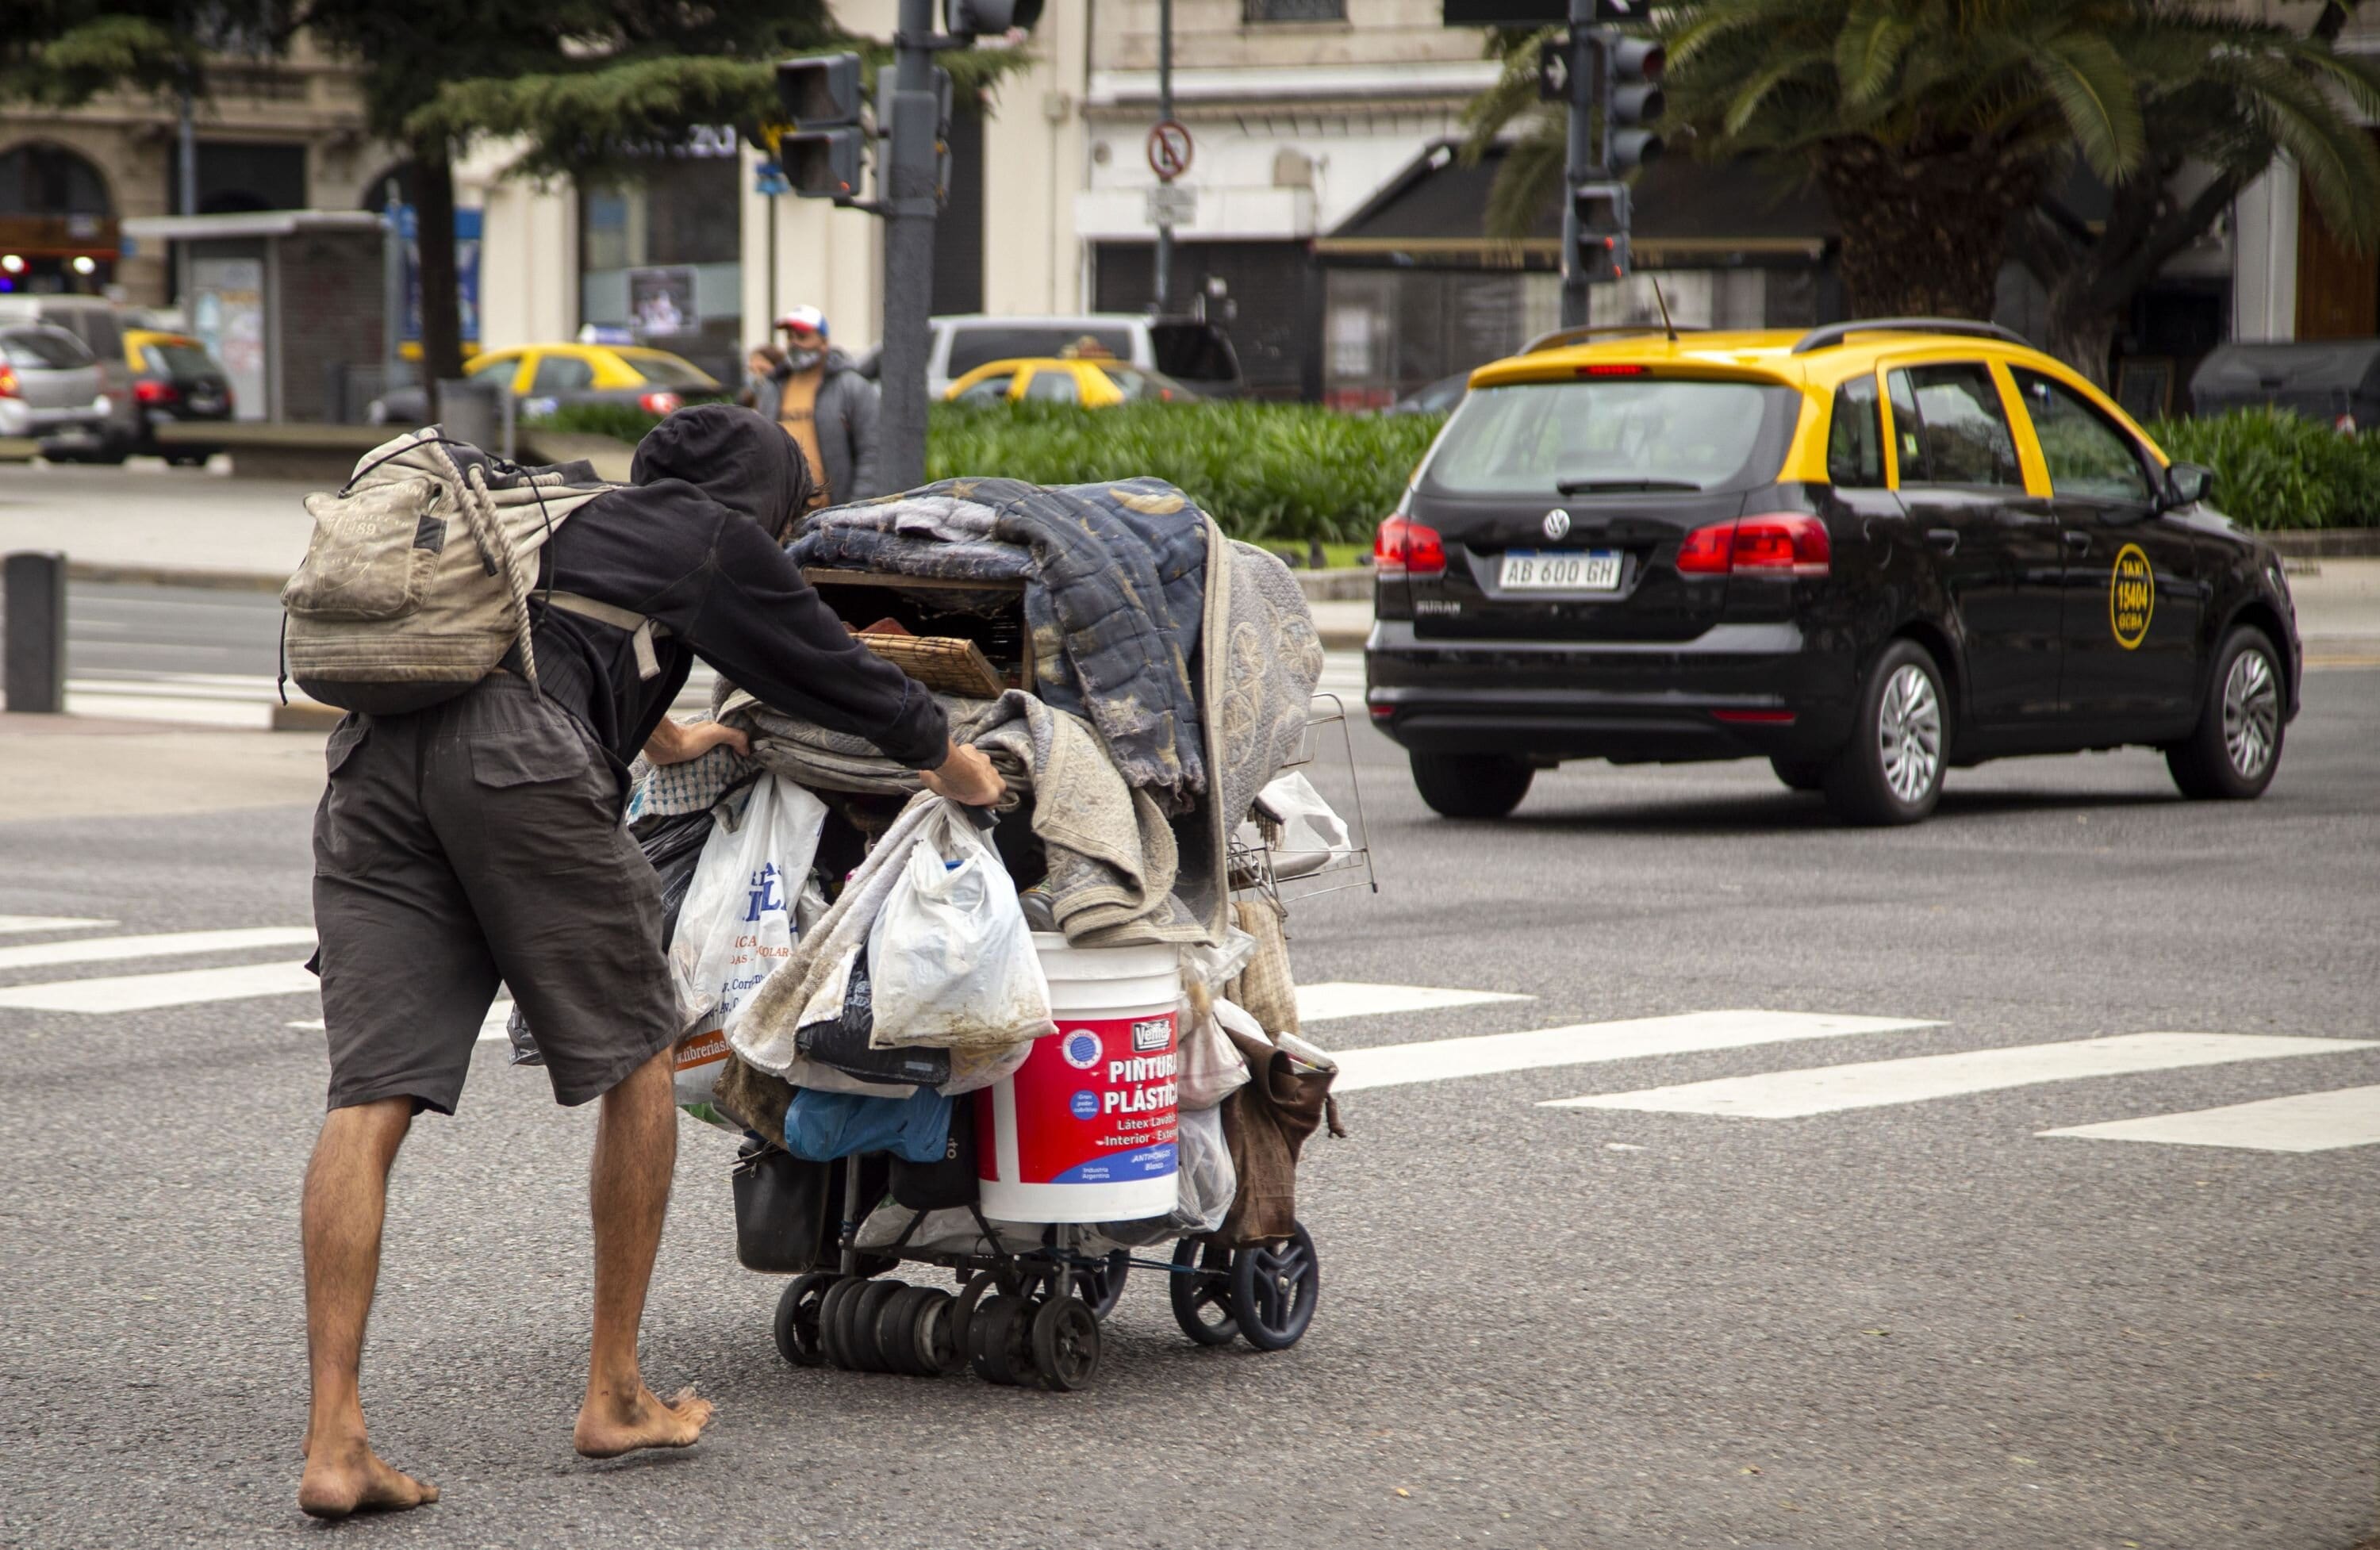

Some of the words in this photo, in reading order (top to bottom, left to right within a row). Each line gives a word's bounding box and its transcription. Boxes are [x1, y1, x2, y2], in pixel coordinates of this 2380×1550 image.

[1507, 559, 1533, 582] AB
[1541, 558, 1580, 582] 600
[1587, 560, 1613, 583] GH
[2121, 560, 2144, 577] TAXI
[2117, 581, 2148, 611] 15404
[1117, 1119, 1149, 1130] Látex
[1105, 1134, 1150, 1146] Interior
